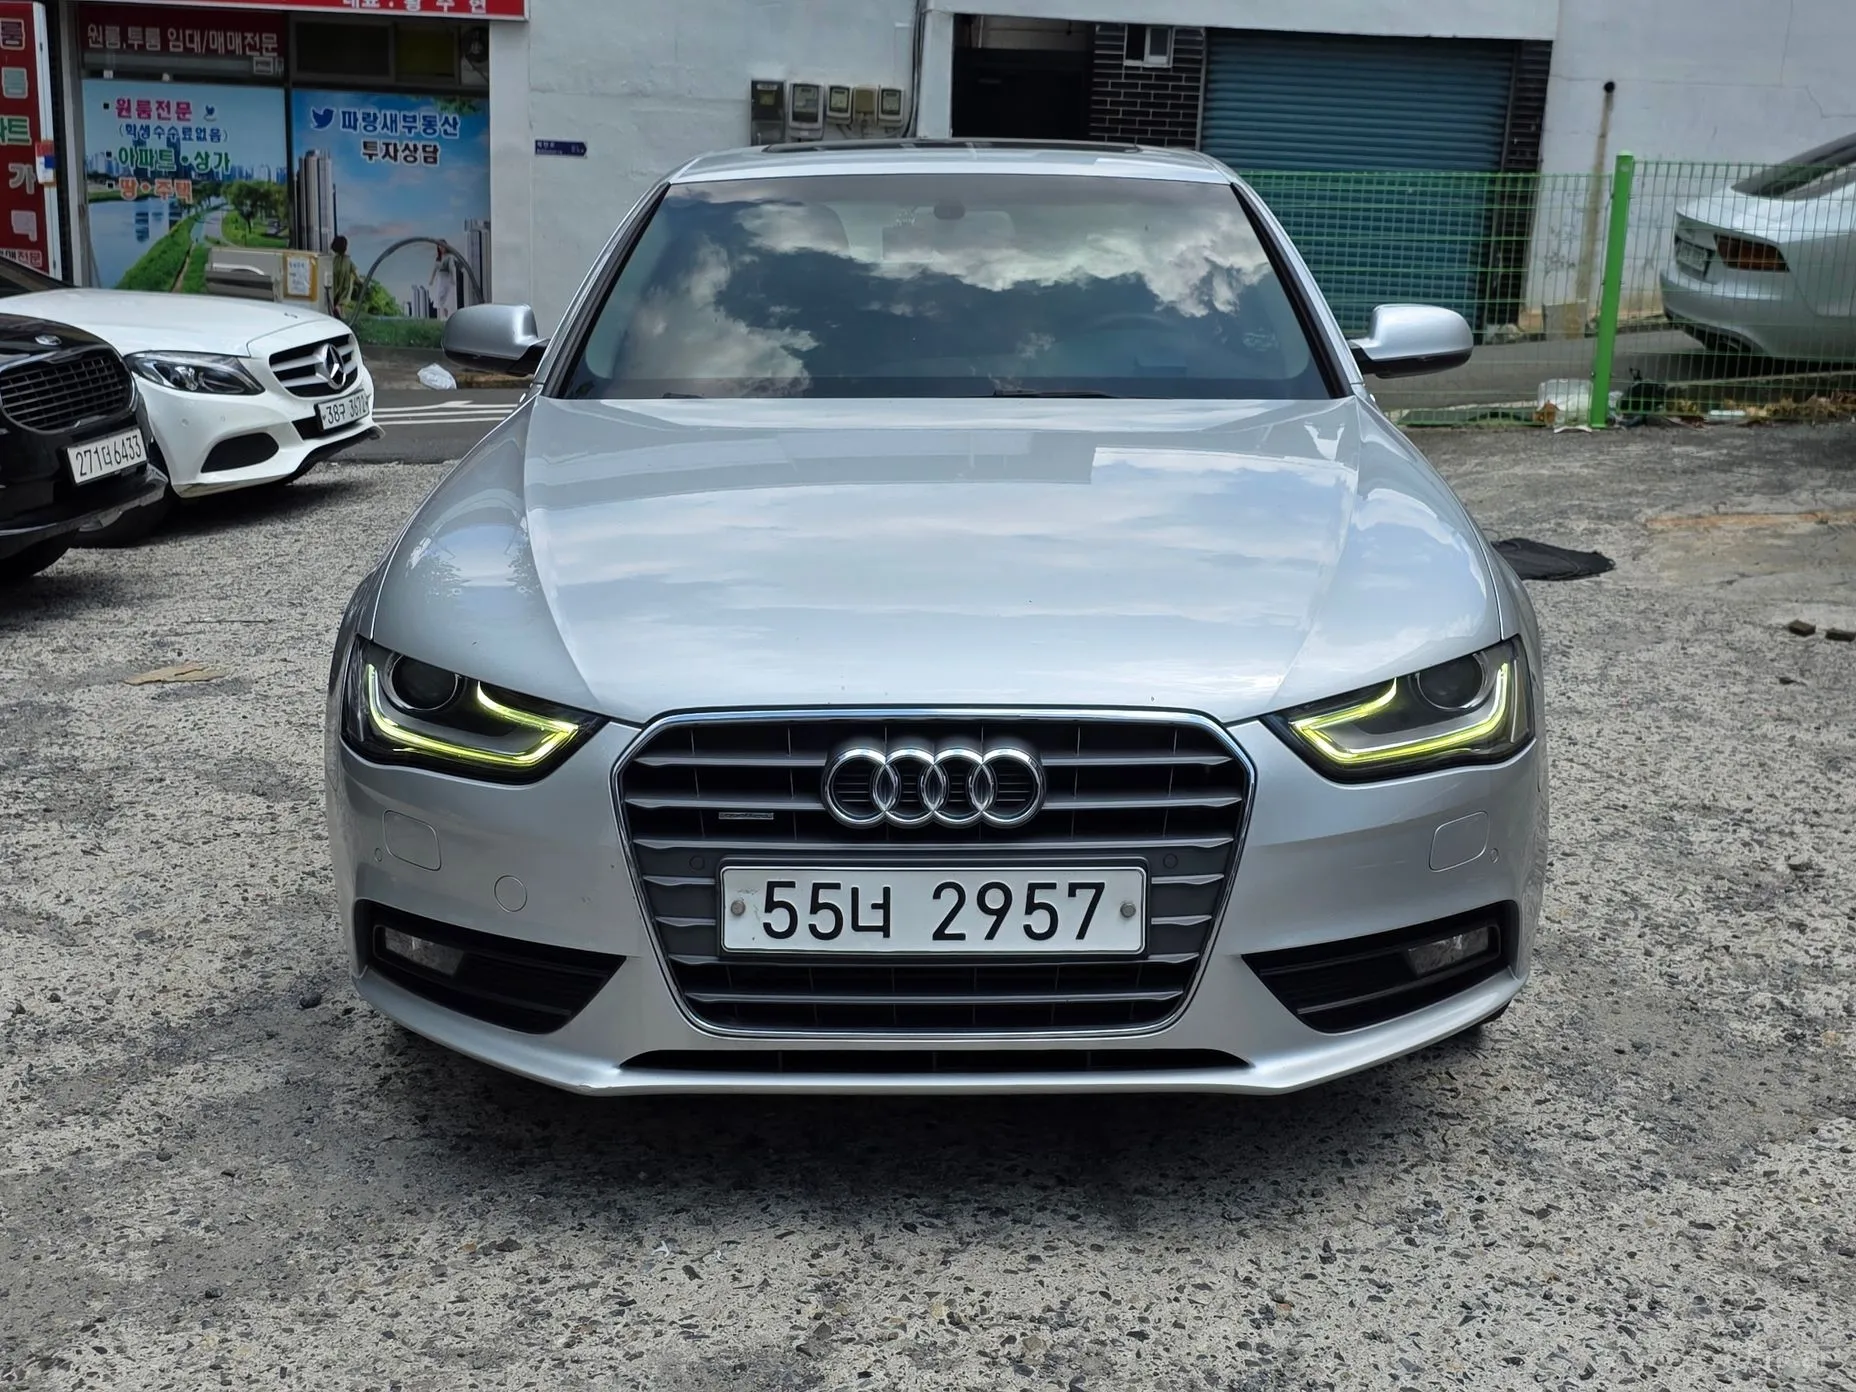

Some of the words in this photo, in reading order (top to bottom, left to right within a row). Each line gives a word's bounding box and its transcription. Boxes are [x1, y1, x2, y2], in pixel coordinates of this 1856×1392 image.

[115, 98, 193, 121] 원룸전문
[340, 109, 460, 137] 파랑새부동산
[361, 140, 440, 165] 투자상담
[762, 880, 891, 941] 55너
[932, 881, 1106, 942] 2957
